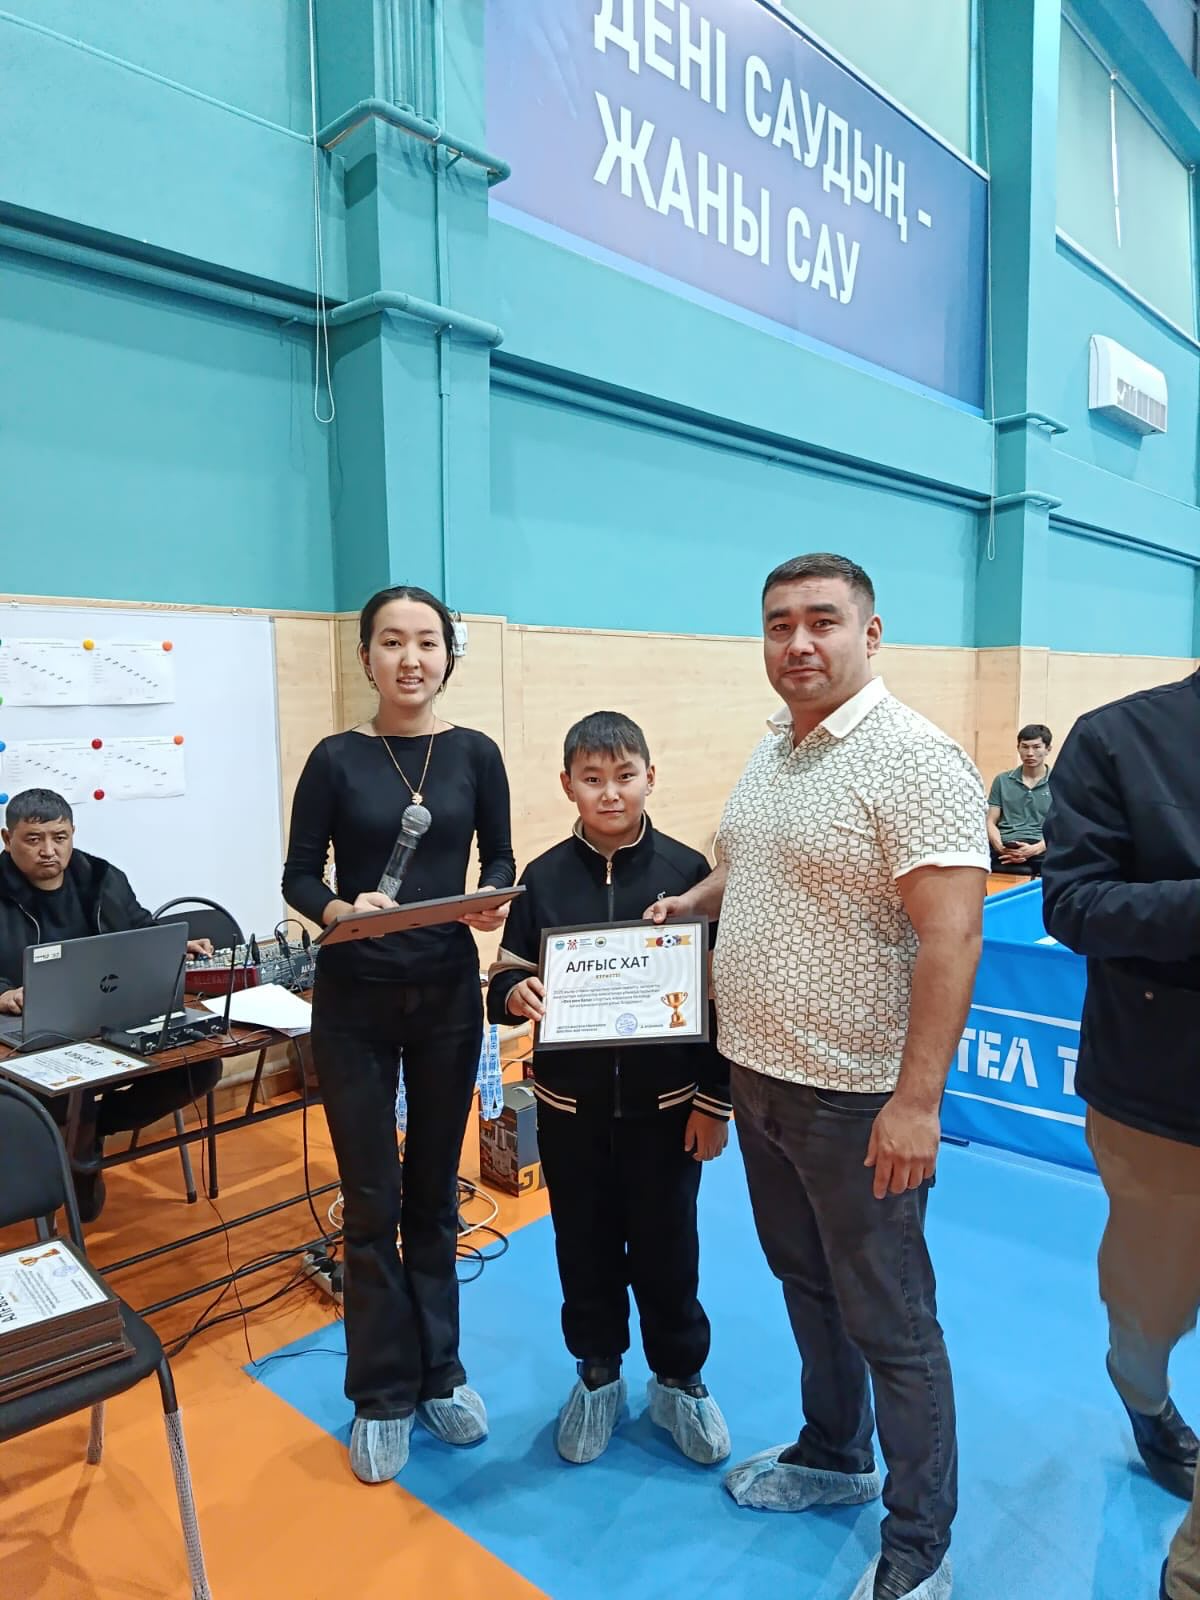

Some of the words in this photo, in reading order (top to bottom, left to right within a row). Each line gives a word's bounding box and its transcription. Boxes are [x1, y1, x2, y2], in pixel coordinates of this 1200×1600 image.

[594, 91, 770, 266] ЖАНЫ
[787, 206, 860, 304] САУ
[745, 55, 907, 243] САУДЫҢ
[566, 959, 617, 973] АЛҒЫС
[620, 956, 649, 969] ХАТ
